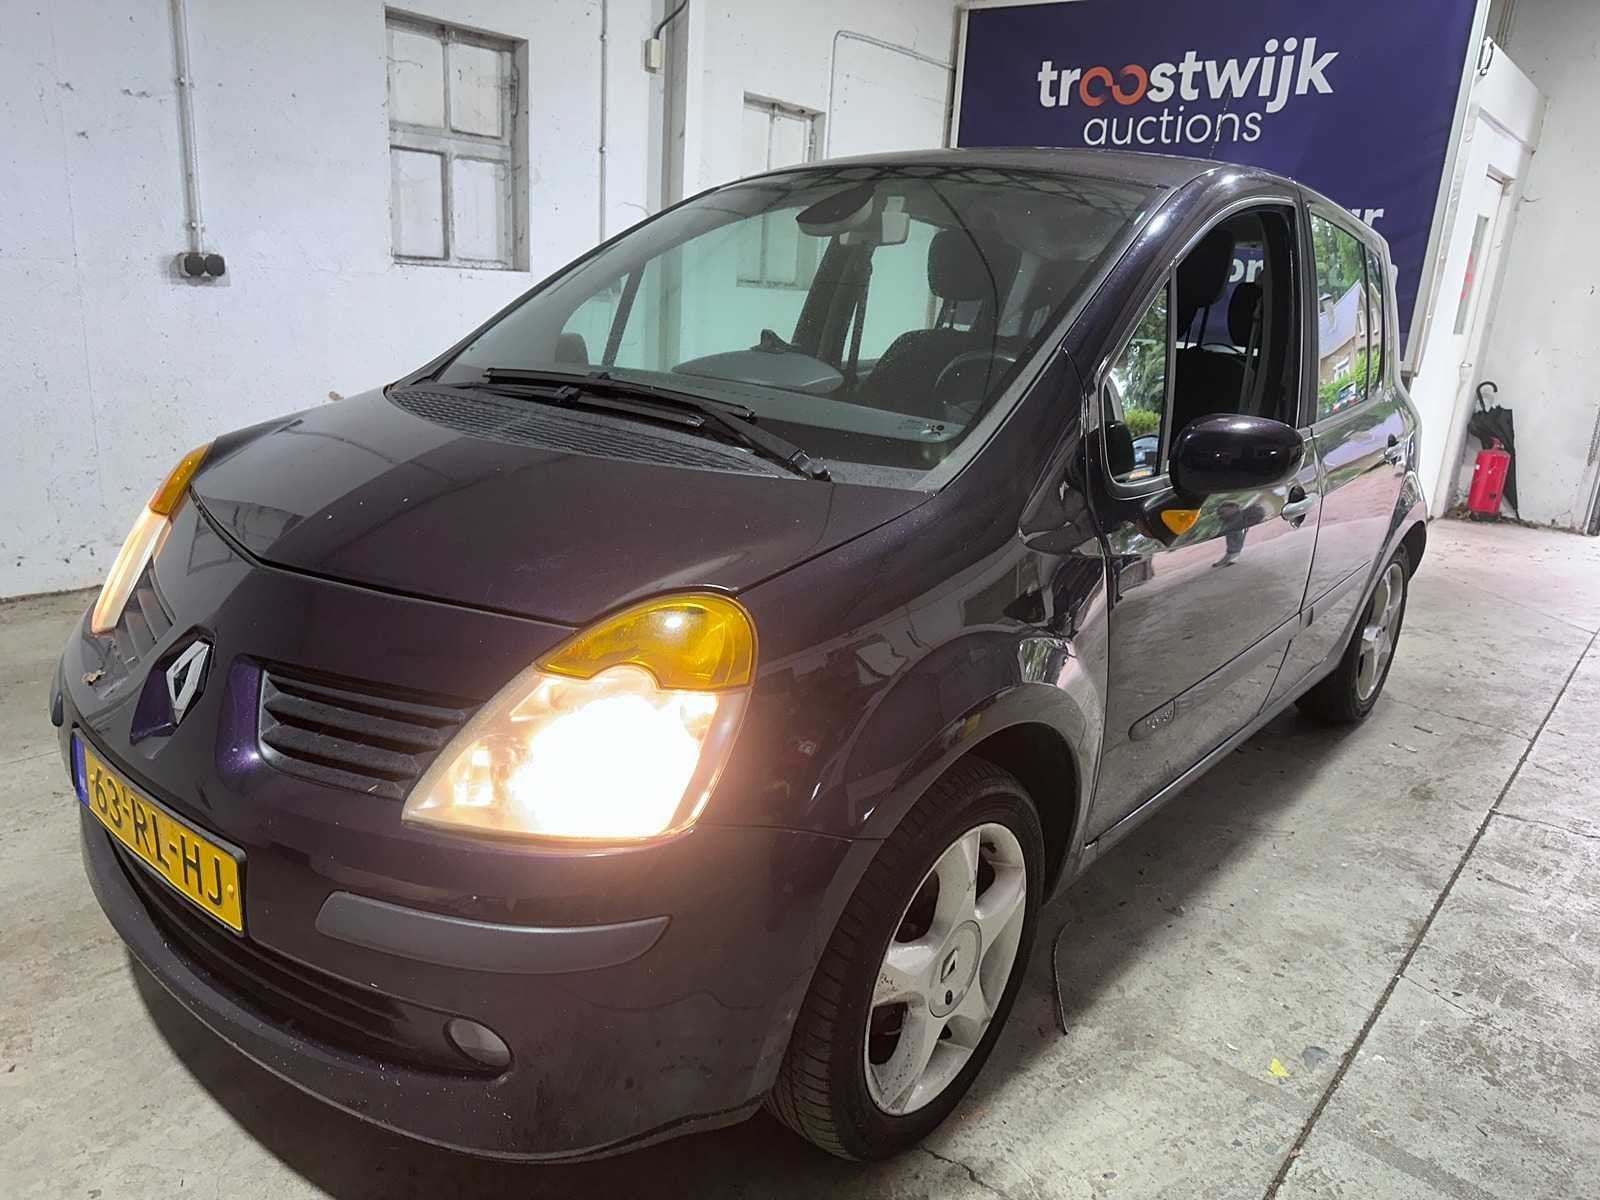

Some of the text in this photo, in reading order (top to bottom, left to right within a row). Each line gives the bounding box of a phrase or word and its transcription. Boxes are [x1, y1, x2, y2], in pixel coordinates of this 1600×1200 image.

[1037, 37, 1339, 113] troostwijk
[1083, 105, 1262, 146] auctions
[95, 767, 223, 906] 63-RL-HJ
